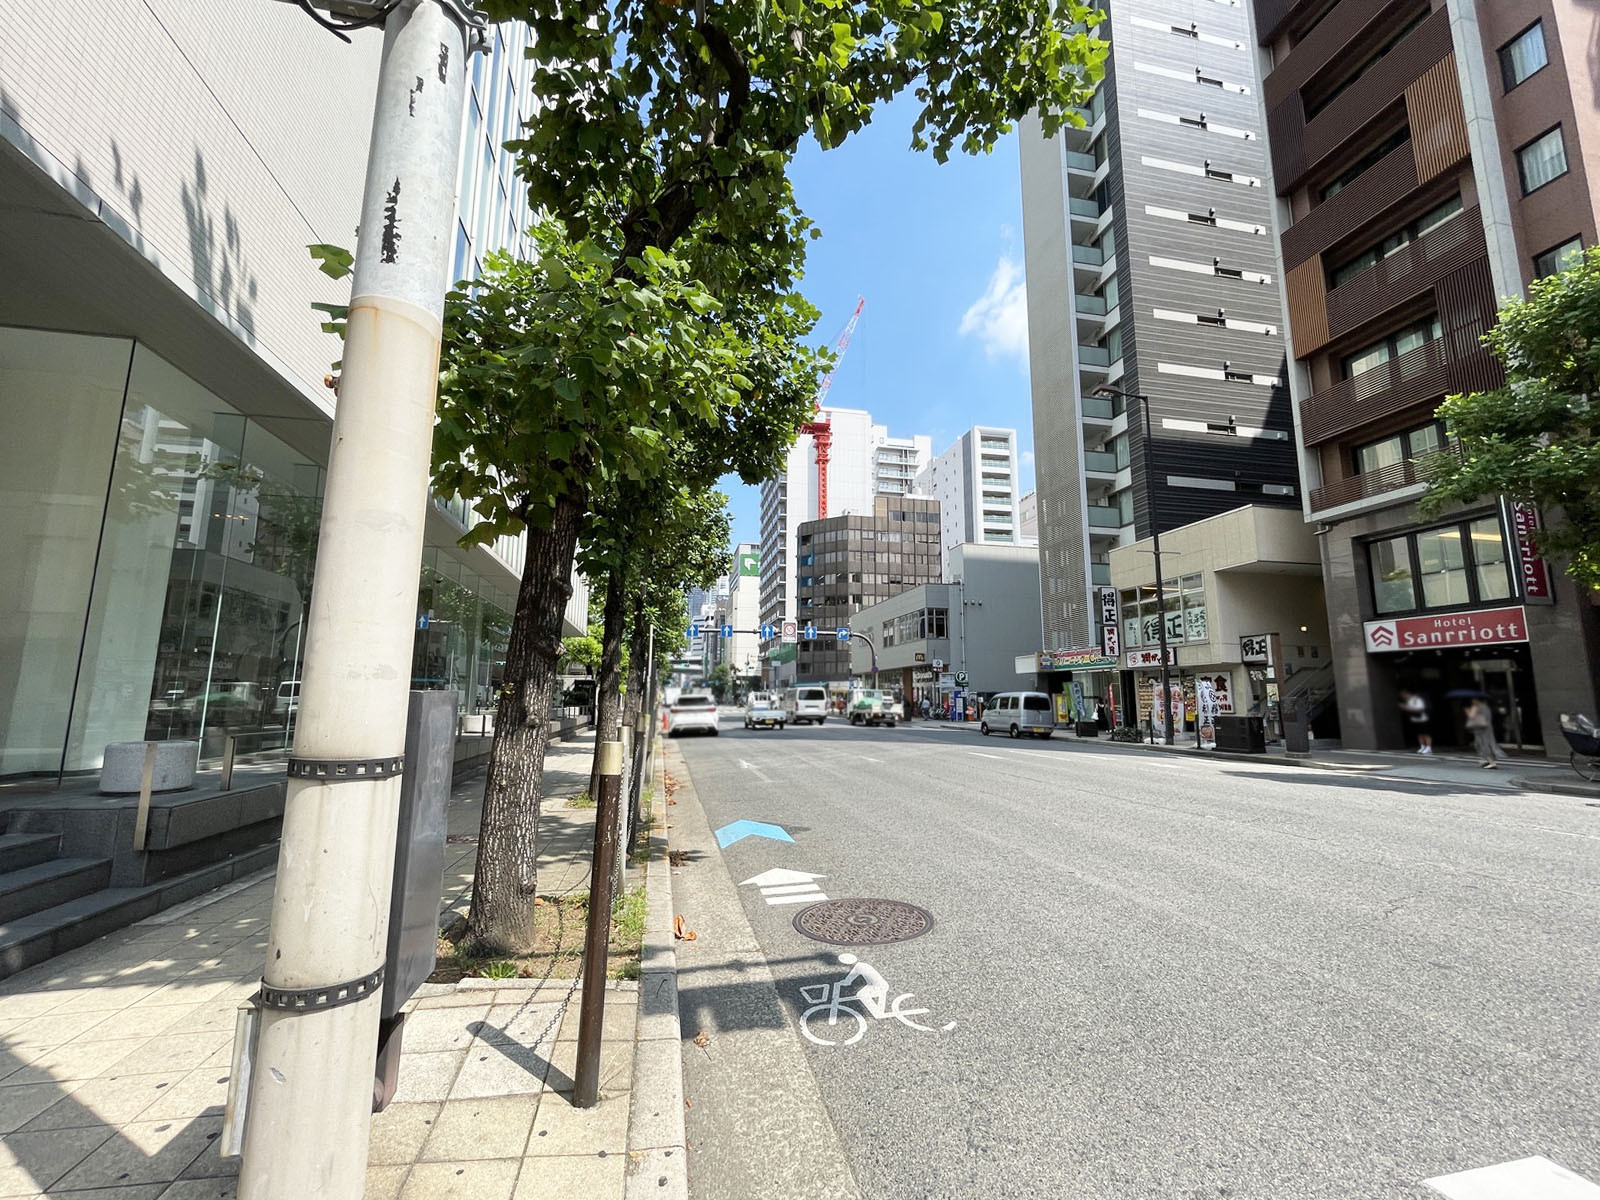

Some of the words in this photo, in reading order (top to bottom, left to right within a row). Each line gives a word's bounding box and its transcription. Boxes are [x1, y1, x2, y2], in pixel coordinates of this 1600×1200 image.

[1101, 592, 1116, 623] 得正
[1403, 622, 1520, 646] Sanrriott
[1434, 616, 1472, 628] Hotel
